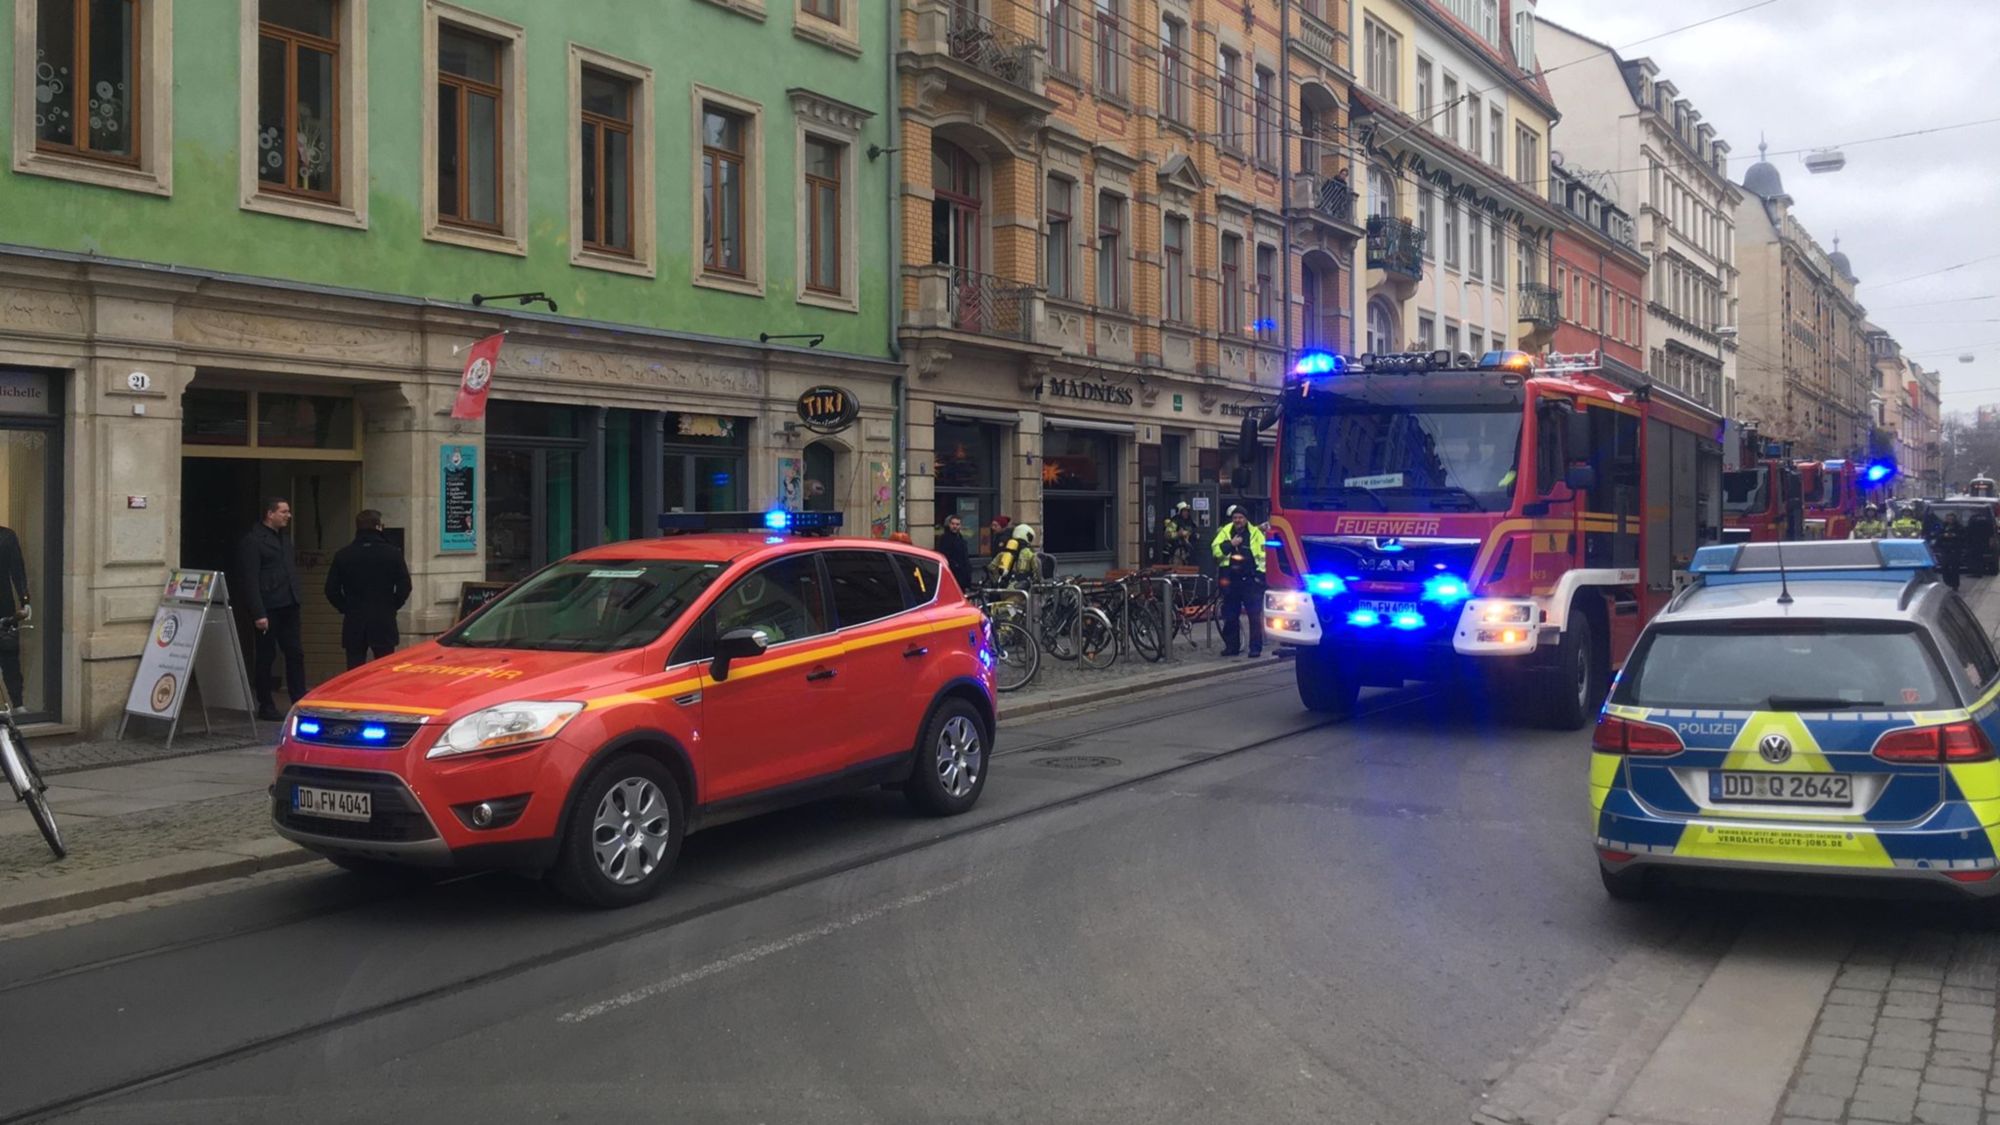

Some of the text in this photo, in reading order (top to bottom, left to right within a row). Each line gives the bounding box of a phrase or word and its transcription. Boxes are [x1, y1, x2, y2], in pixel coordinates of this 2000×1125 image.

[132, 376, 146, 389] 21
[1050, 377, 1133, 406] MADNESS
[0, 387, 42, 399] ichelle
[803, 393, 843, 417] TIKI
[1334, 516, 1441, 536] FEUERWEHR
[1358, 559, 1415, 571] MAN
[1678, 722, 1737, 735] POLIZEI
[1724, 775, 1848, 799] DD Q 2642
[299, 789, 370, 815] DD FW 4041
